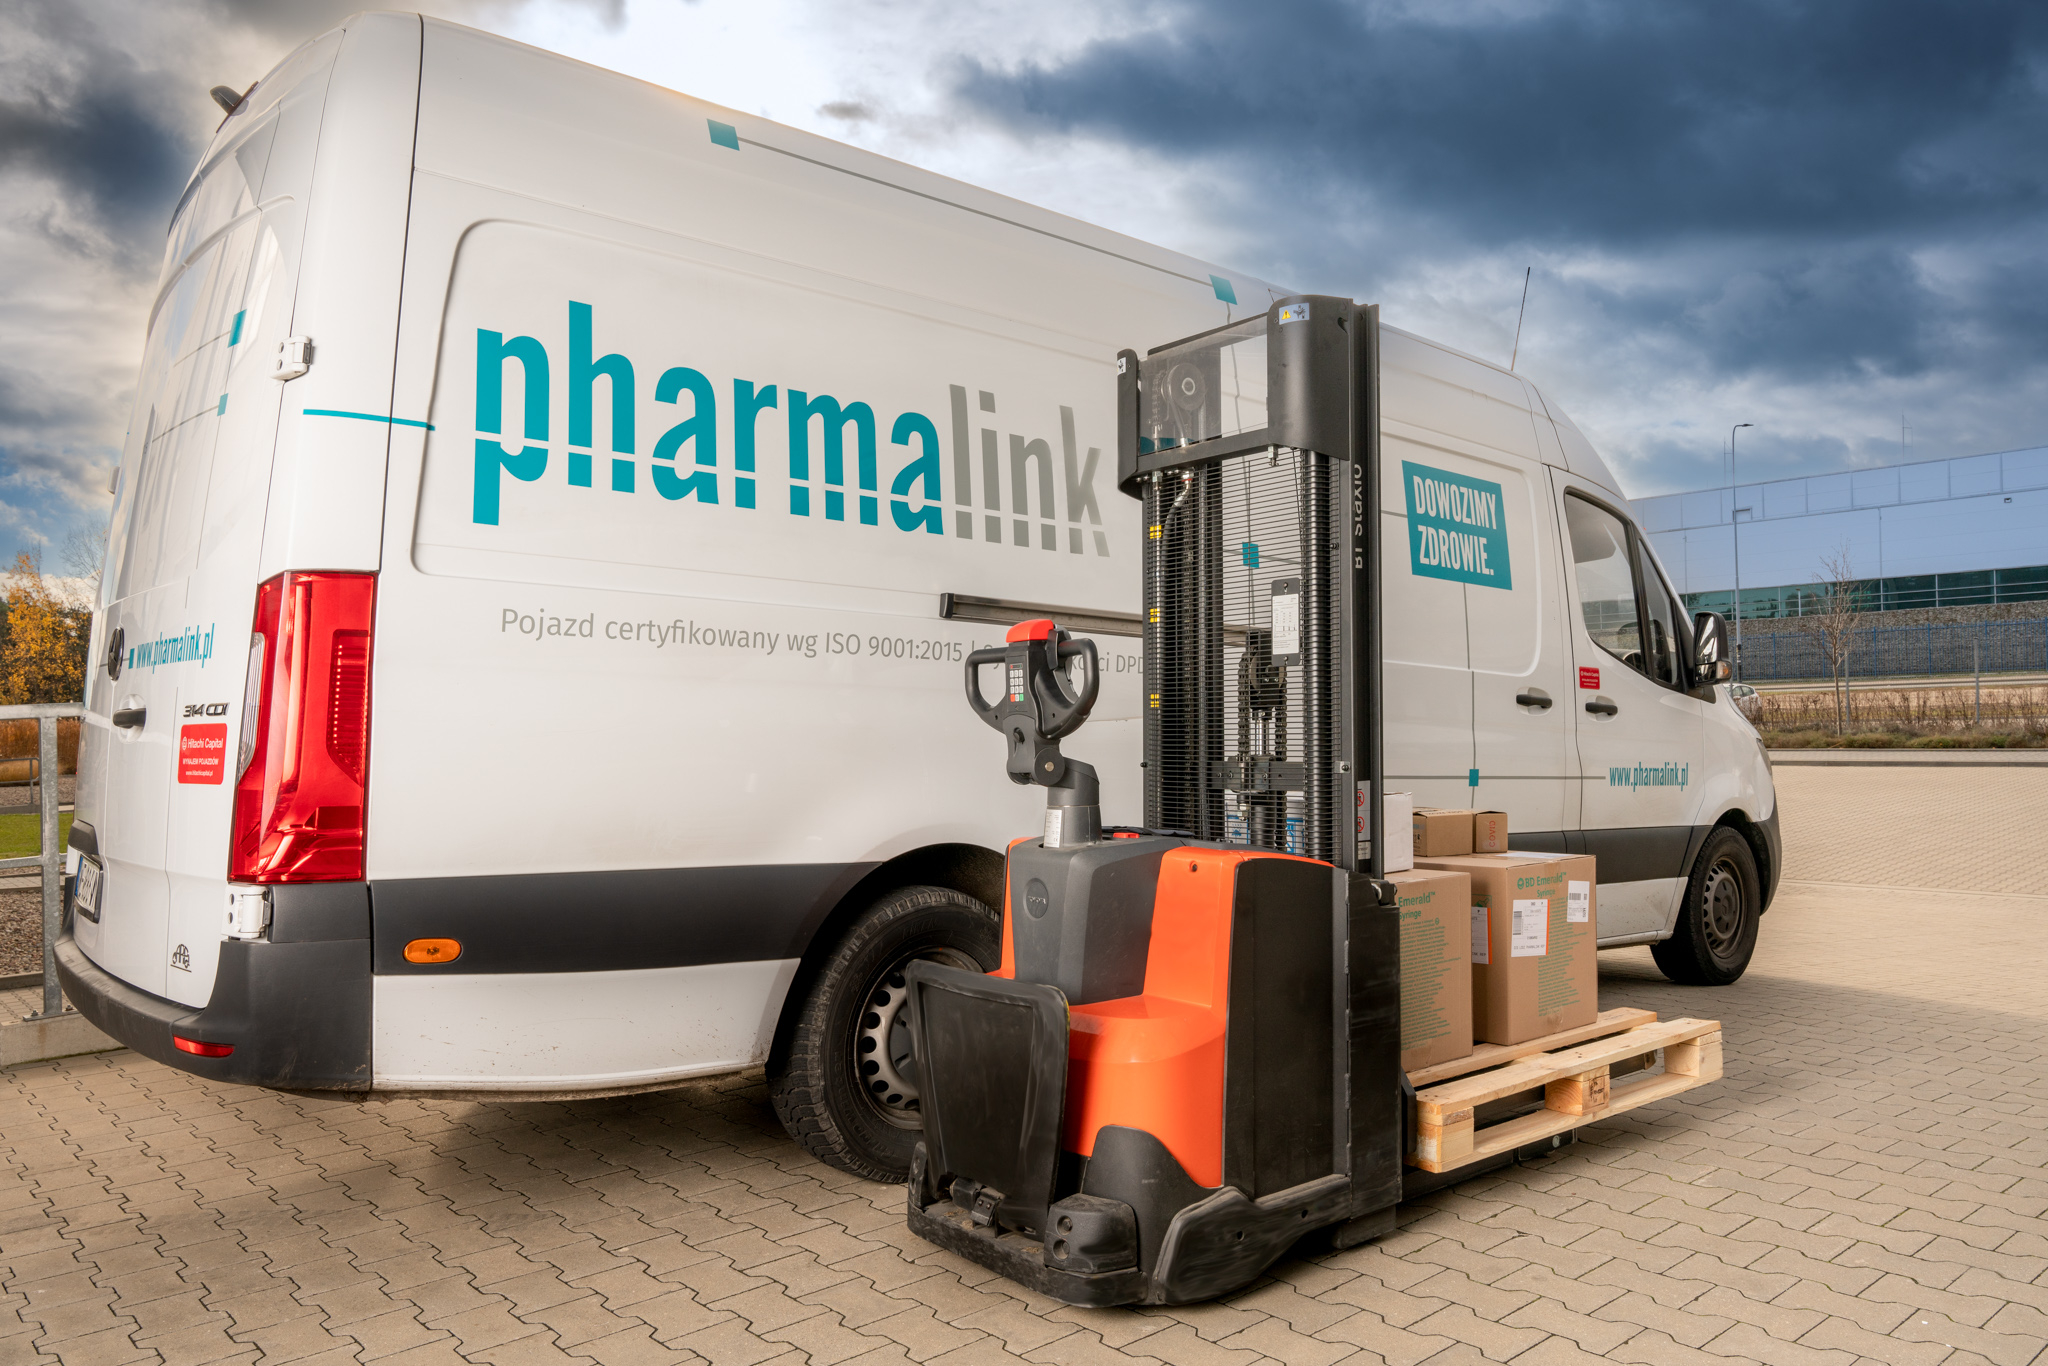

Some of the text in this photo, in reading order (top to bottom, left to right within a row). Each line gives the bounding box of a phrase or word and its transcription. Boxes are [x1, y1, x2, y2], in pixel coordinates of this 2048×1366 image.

[472, 300, 1111, 558] pharmalink
[1412, 475, 1497, 530] DOWOZIMY
[1417, 524, 1495, 576] ZDROWIE.
[136, 622, 215, 675] www.pharmalink.pl
[500, 608, 595, 641] Pojazd
[604, 619, 780, 656] certyfikowany
[787, 632, 819, 658] wg
[824, 632, 861, 656] ISO
[868, 636, 963, 662] 9001:2015
[183, 702, 229, 717] 314 CDI
[187, 737, 224, 750] Hitachi Capital
[1609, 761, 1689, 792] www.pharmalink.pl
[1524, 877, 1535, 888] BD
[1536, 888, 1556, 898] Syringe
